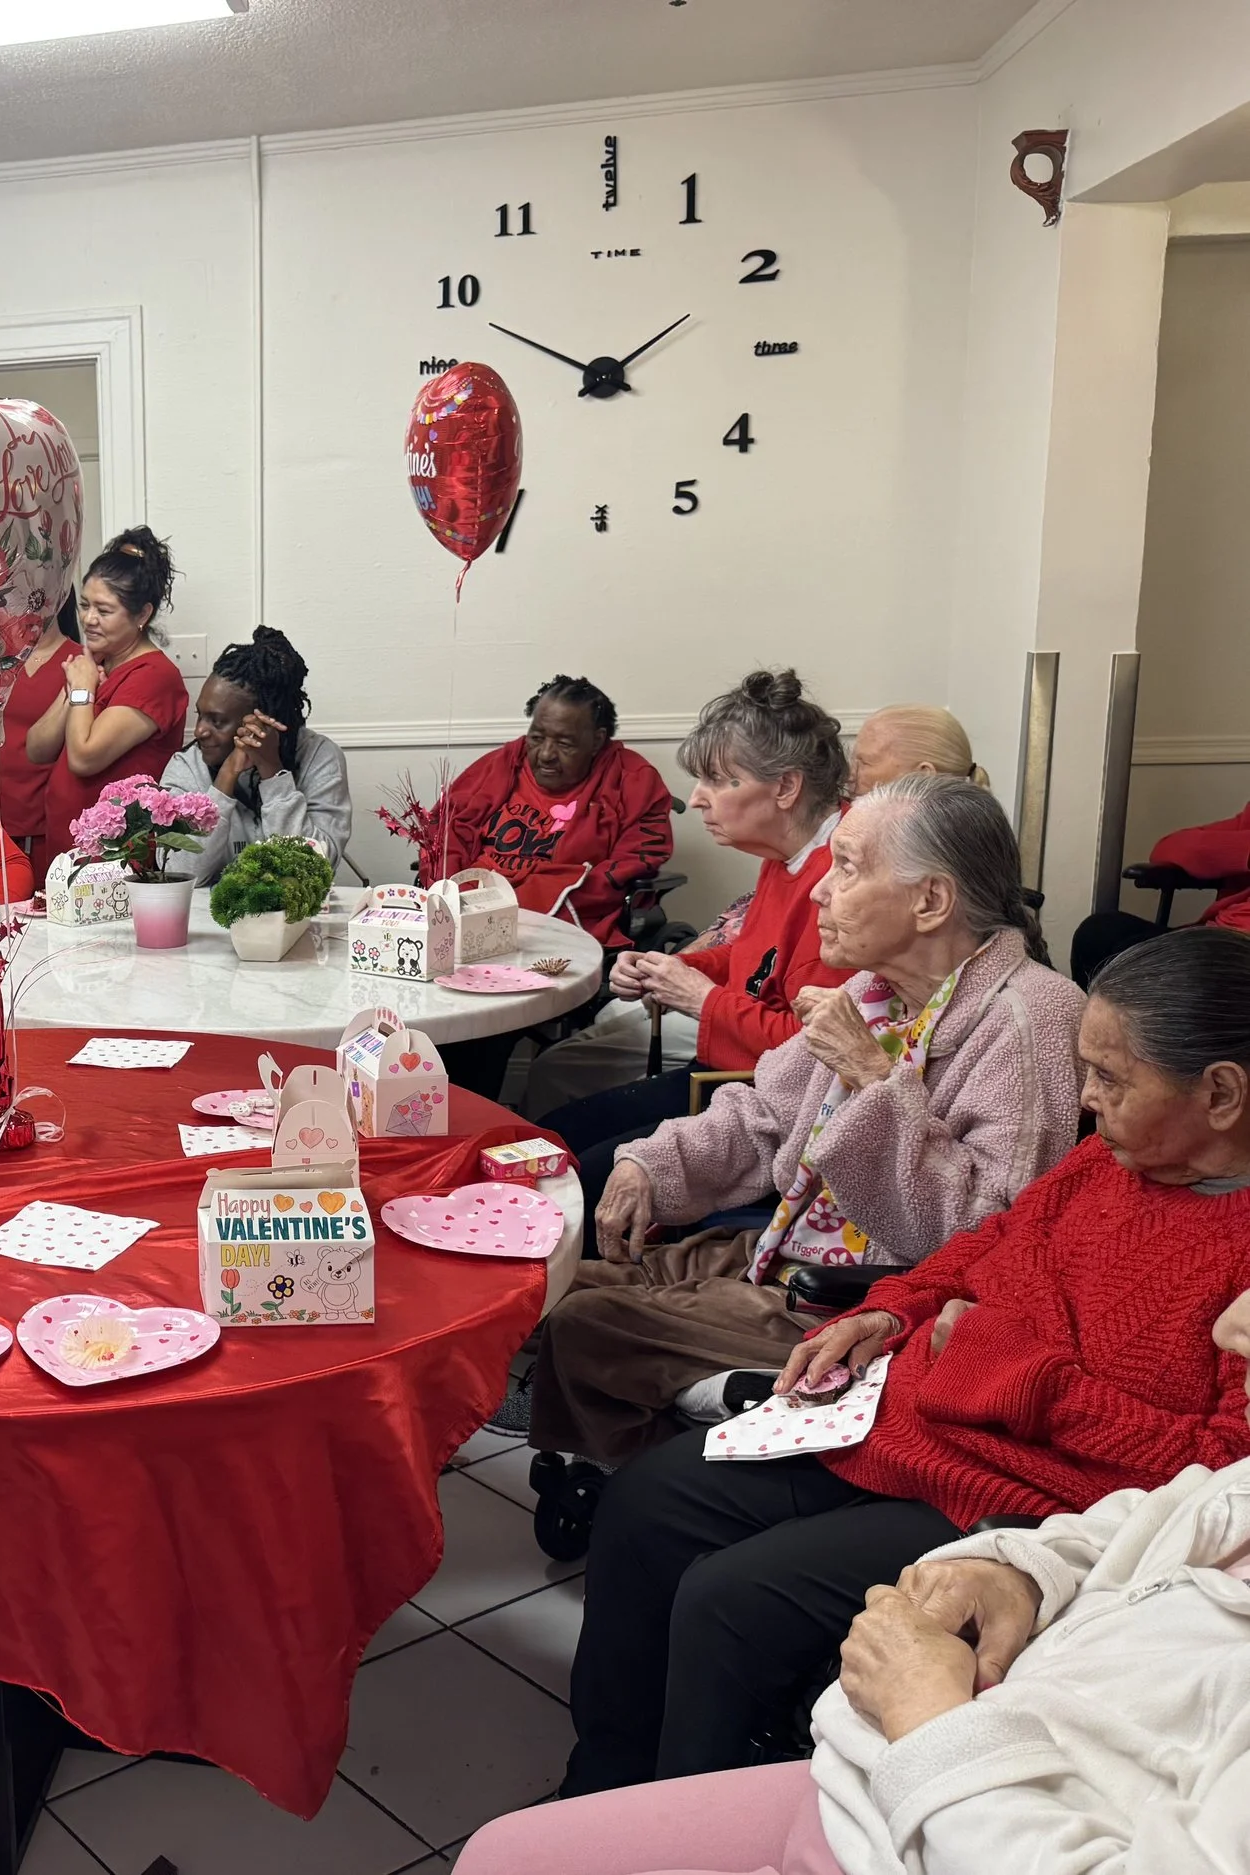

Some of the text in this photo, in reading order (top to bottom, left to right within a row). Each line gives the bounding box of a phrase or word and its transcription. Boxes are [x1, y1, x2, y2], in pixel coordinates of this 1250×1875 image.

[600, 135, 618, 212] twelve
[679, 172, 703, 224] 1
[494, 202, 537, 237] 11
[590, 248, 642, 259] TIME
[739, 249, 780, 284] 2
[436, 274, 481, 309] 10
[753, 340, 799, 357] three
[723, 412, 755, 453] 4
[404, 442, 438, 478] tine's
[672, 479, 699, 515] 5
[590, 504, 608, 532] six
[217, 1192, 271, 1220] Happy
[216, 1216, 367, 1241] VALENTINE'S
[221, 1243, 271, 1268] DAY!
[792, 1241, 825, 1258] Tigger
